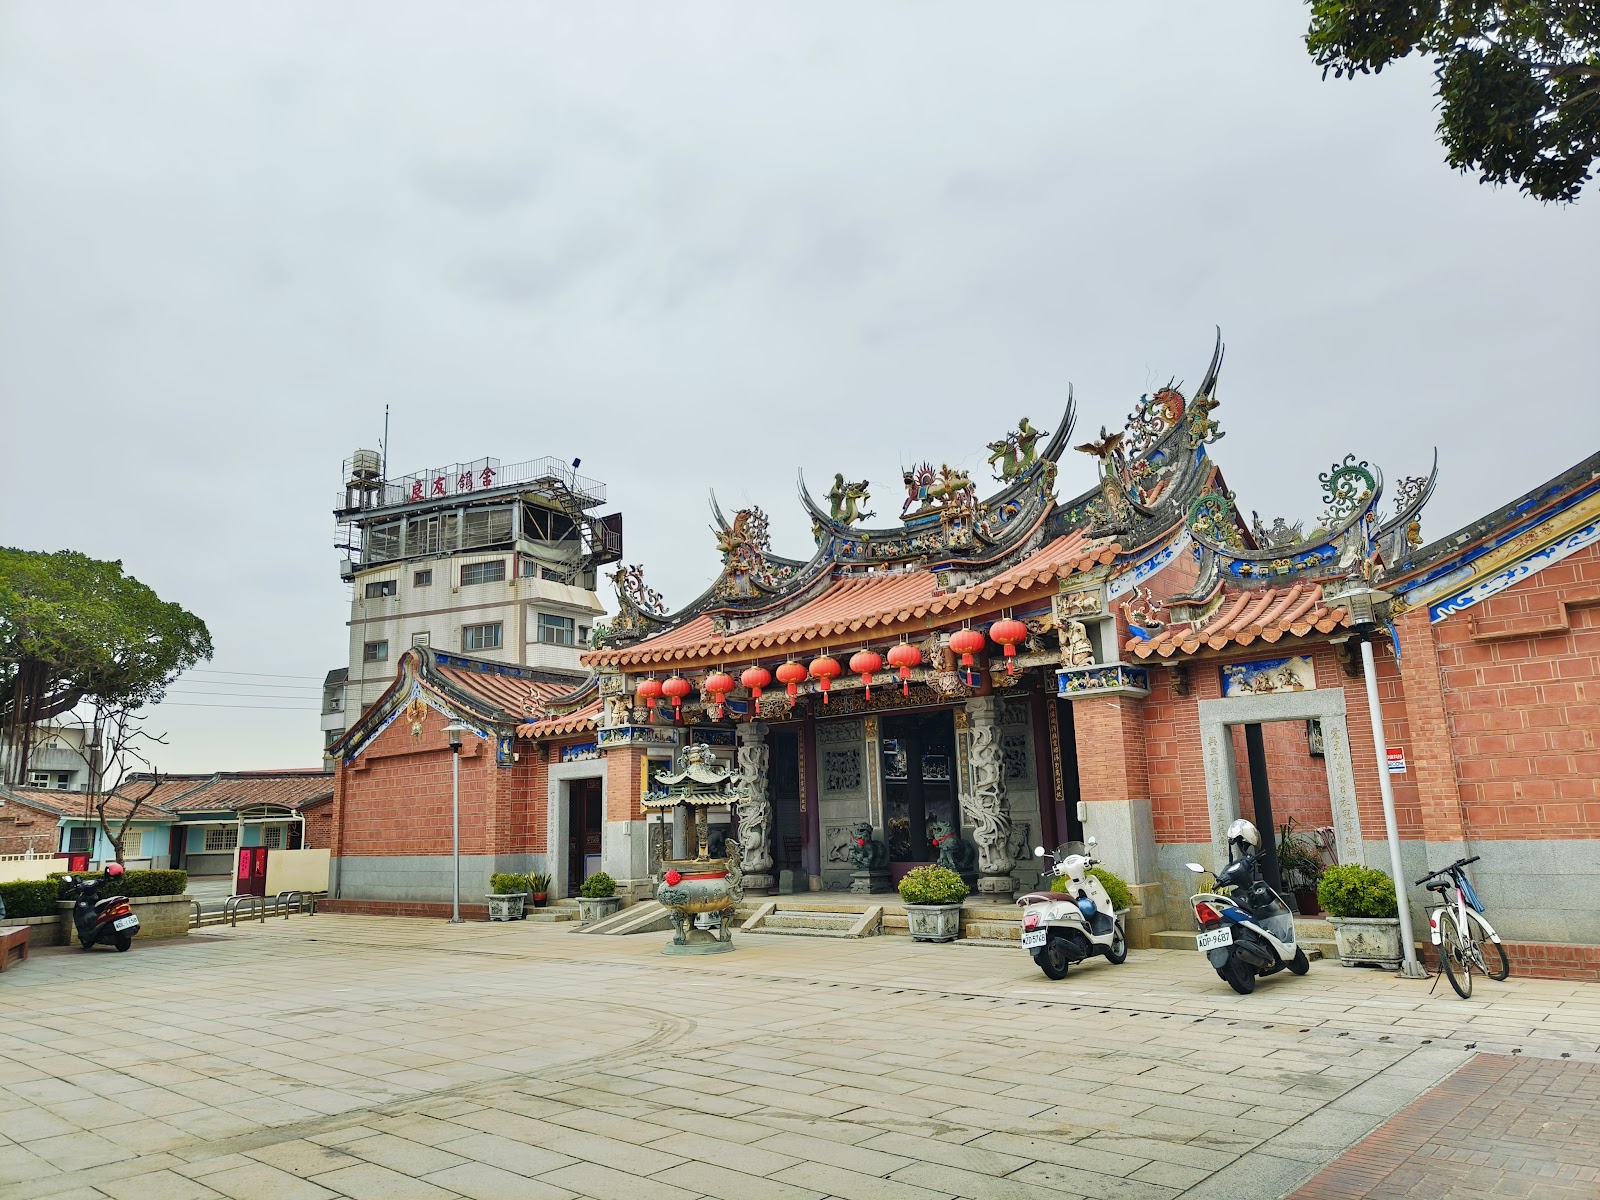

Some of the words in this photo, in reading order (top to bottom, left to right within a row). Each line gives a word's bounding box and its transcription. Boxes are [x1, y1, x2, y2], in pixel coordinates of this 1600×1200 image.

[410, 466, 497, 502] 良友鴿舍
[1199, 932, 1230, 948] ADP-9687
